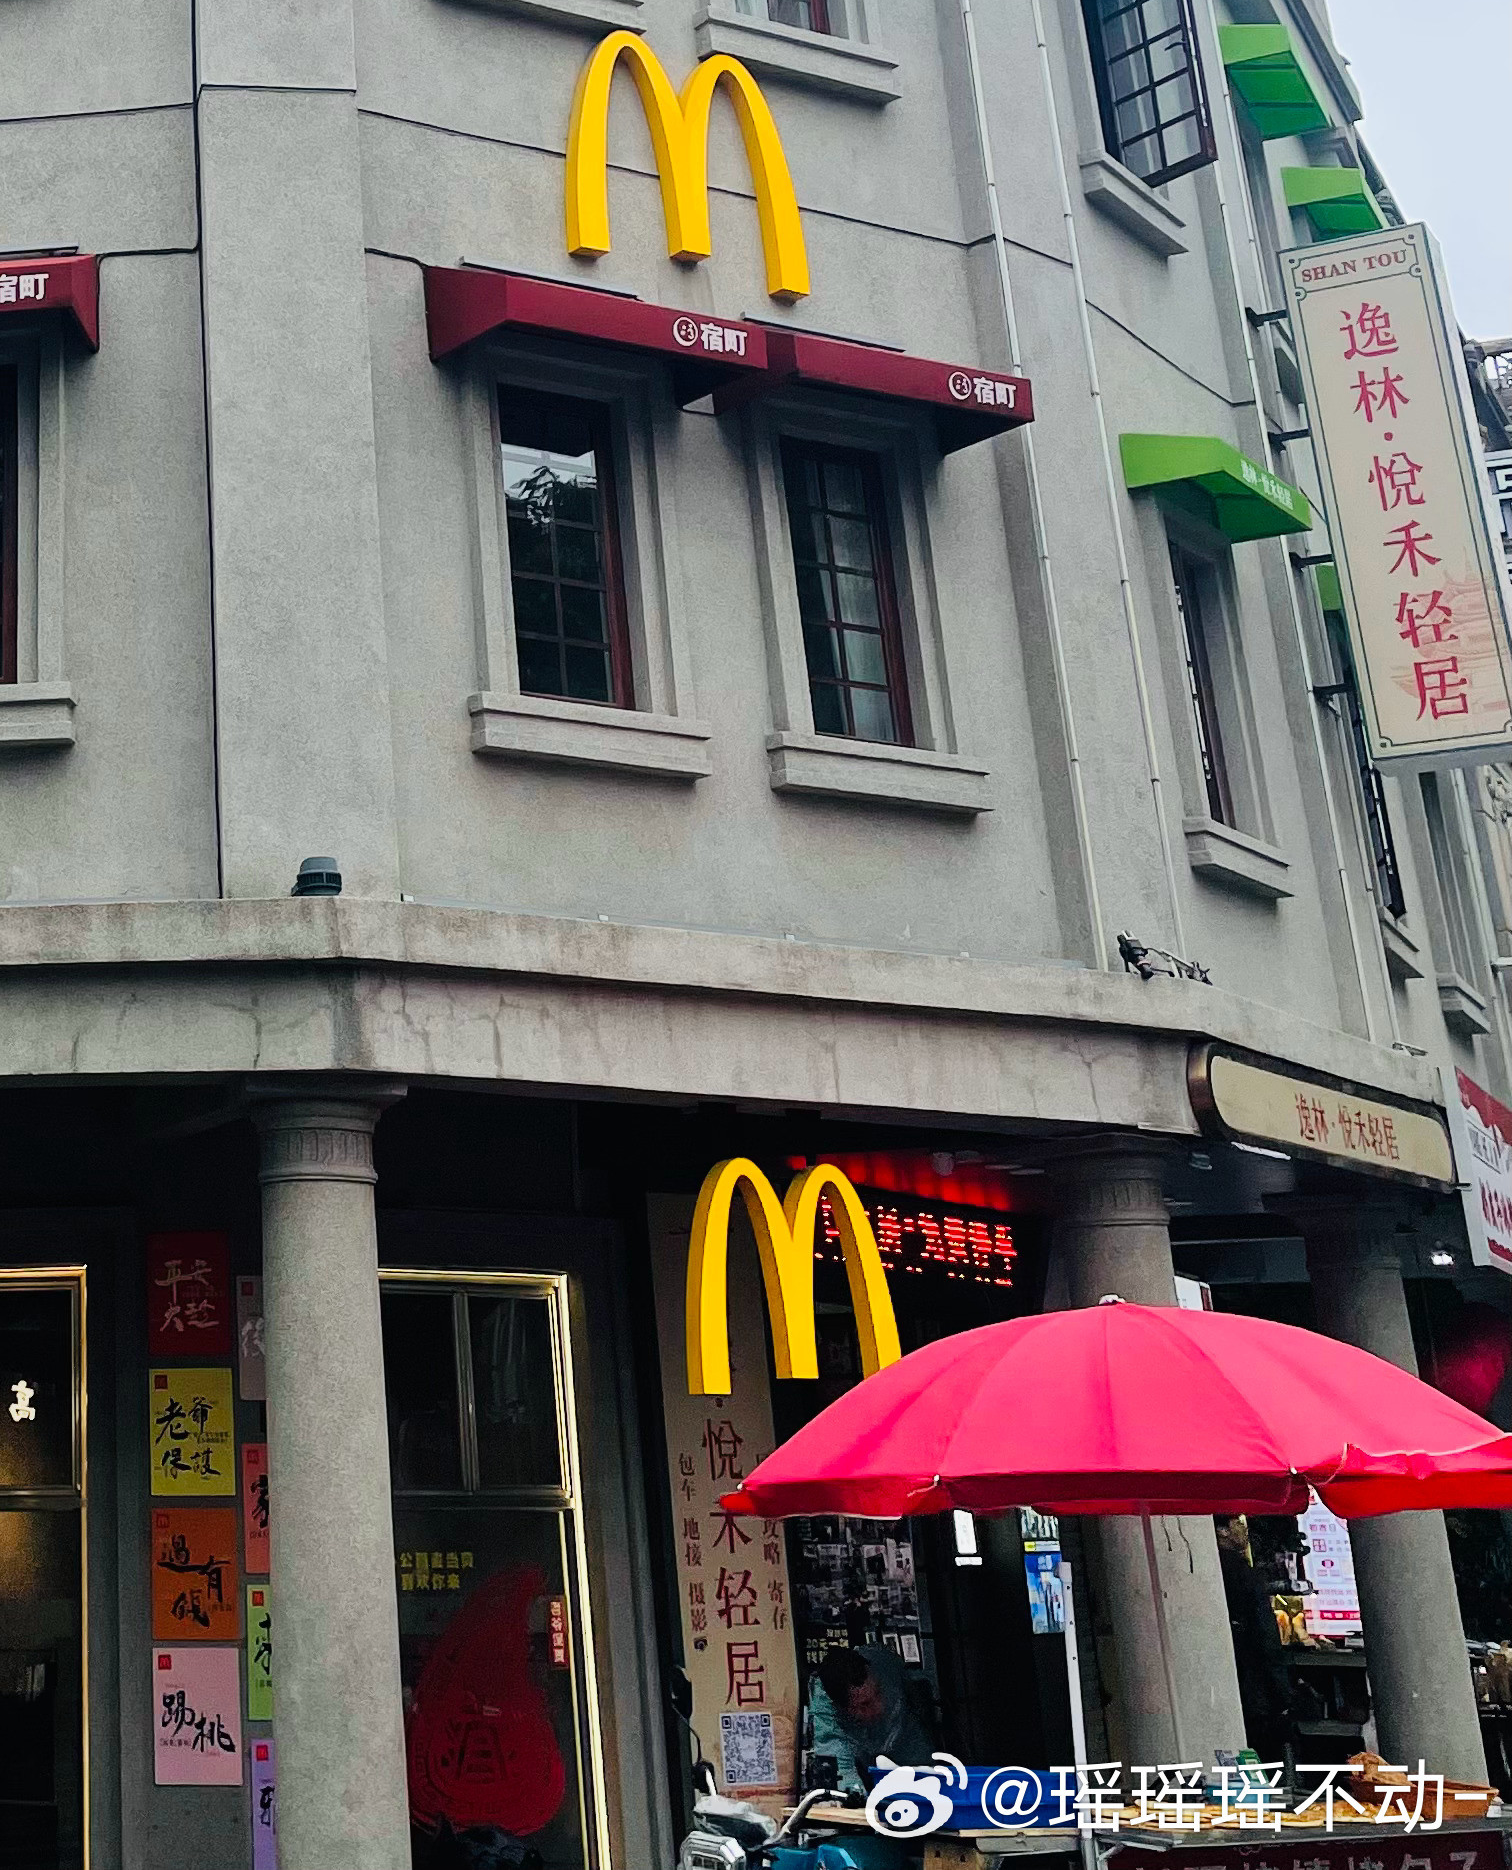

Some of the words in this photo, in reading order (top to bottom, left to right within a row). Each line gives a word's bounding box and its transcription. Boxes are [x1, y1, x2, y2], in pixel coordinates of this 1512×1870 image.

[1301, 259, 1357, 283] SHAN
[1362, 249, 1407, 271] TOU
[700, 323, 748, 356] 宿町
[973, 376, 1017, 409] 宿町
